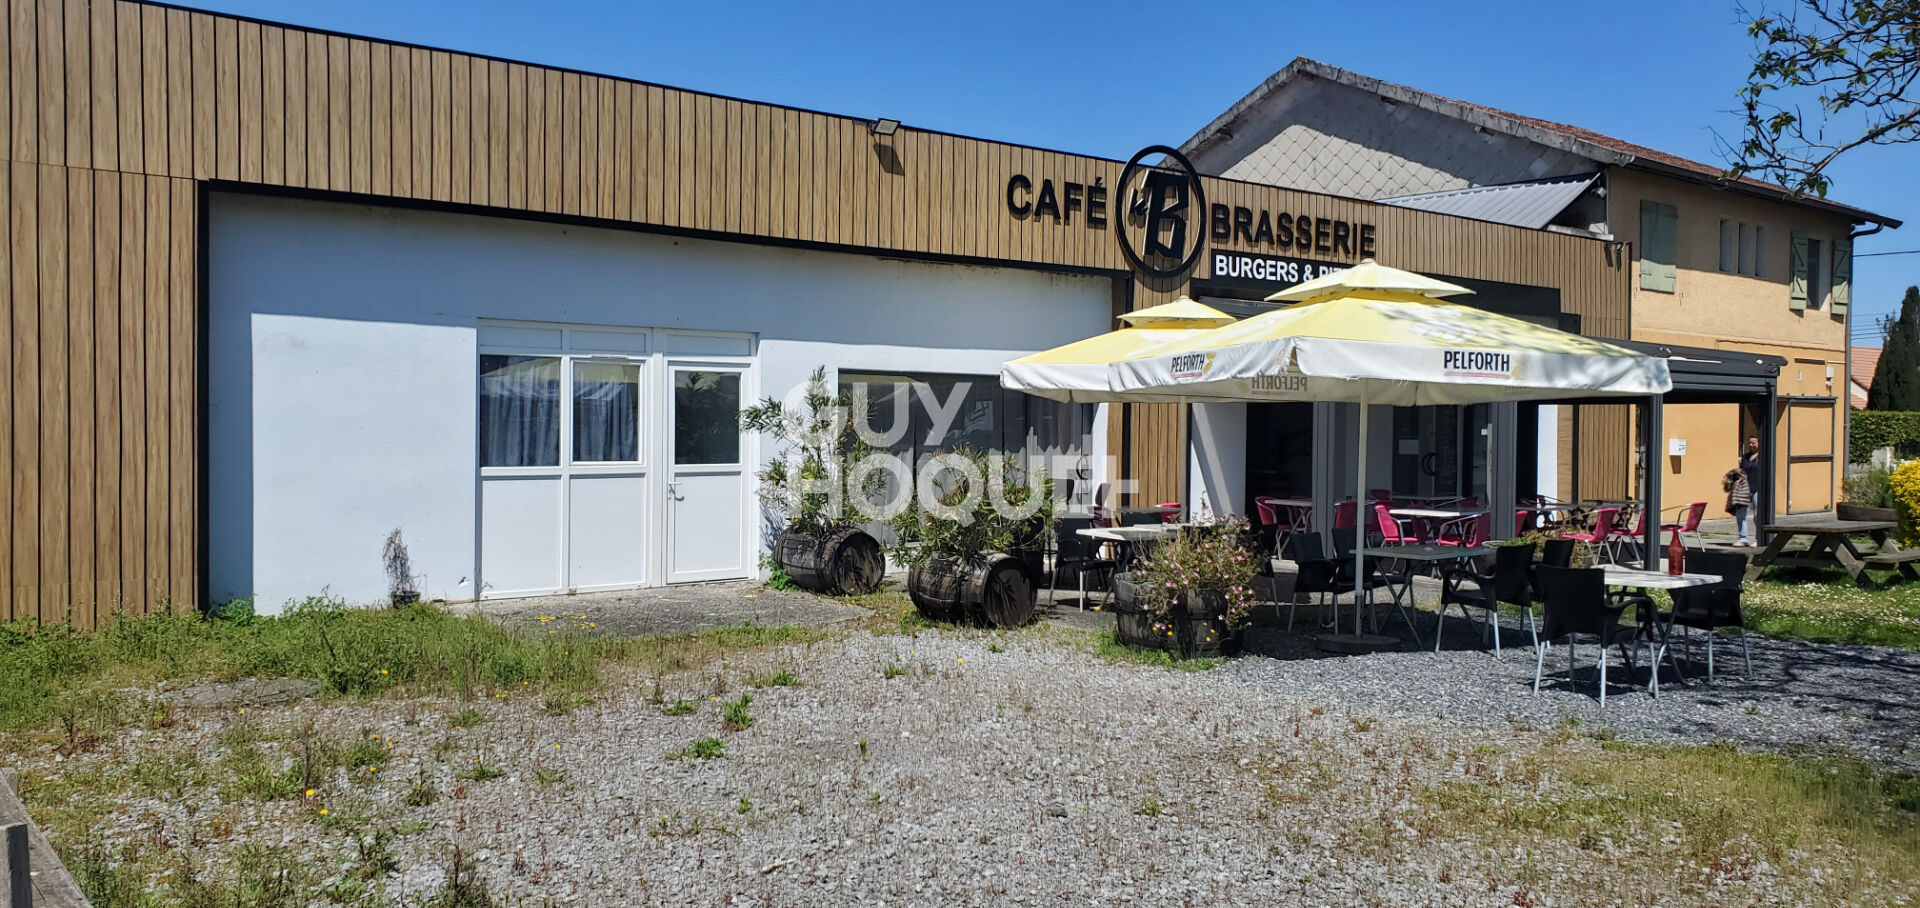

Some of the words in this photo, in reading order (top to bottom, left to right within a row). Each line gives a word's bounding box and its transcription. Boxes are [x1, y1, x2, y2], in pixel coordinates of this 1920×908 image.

[1007, 174, 1107, 223] CAFÉ
[1212, 203, 1376, 257] BRASSERIE
[1215, 254, 1299, 283] BURGERS
[1303, 264, 1314, 283] &
[1171, 353, 1205, 373] PELFORTH
[1444, 351, 1510, 372] PELFORTH
